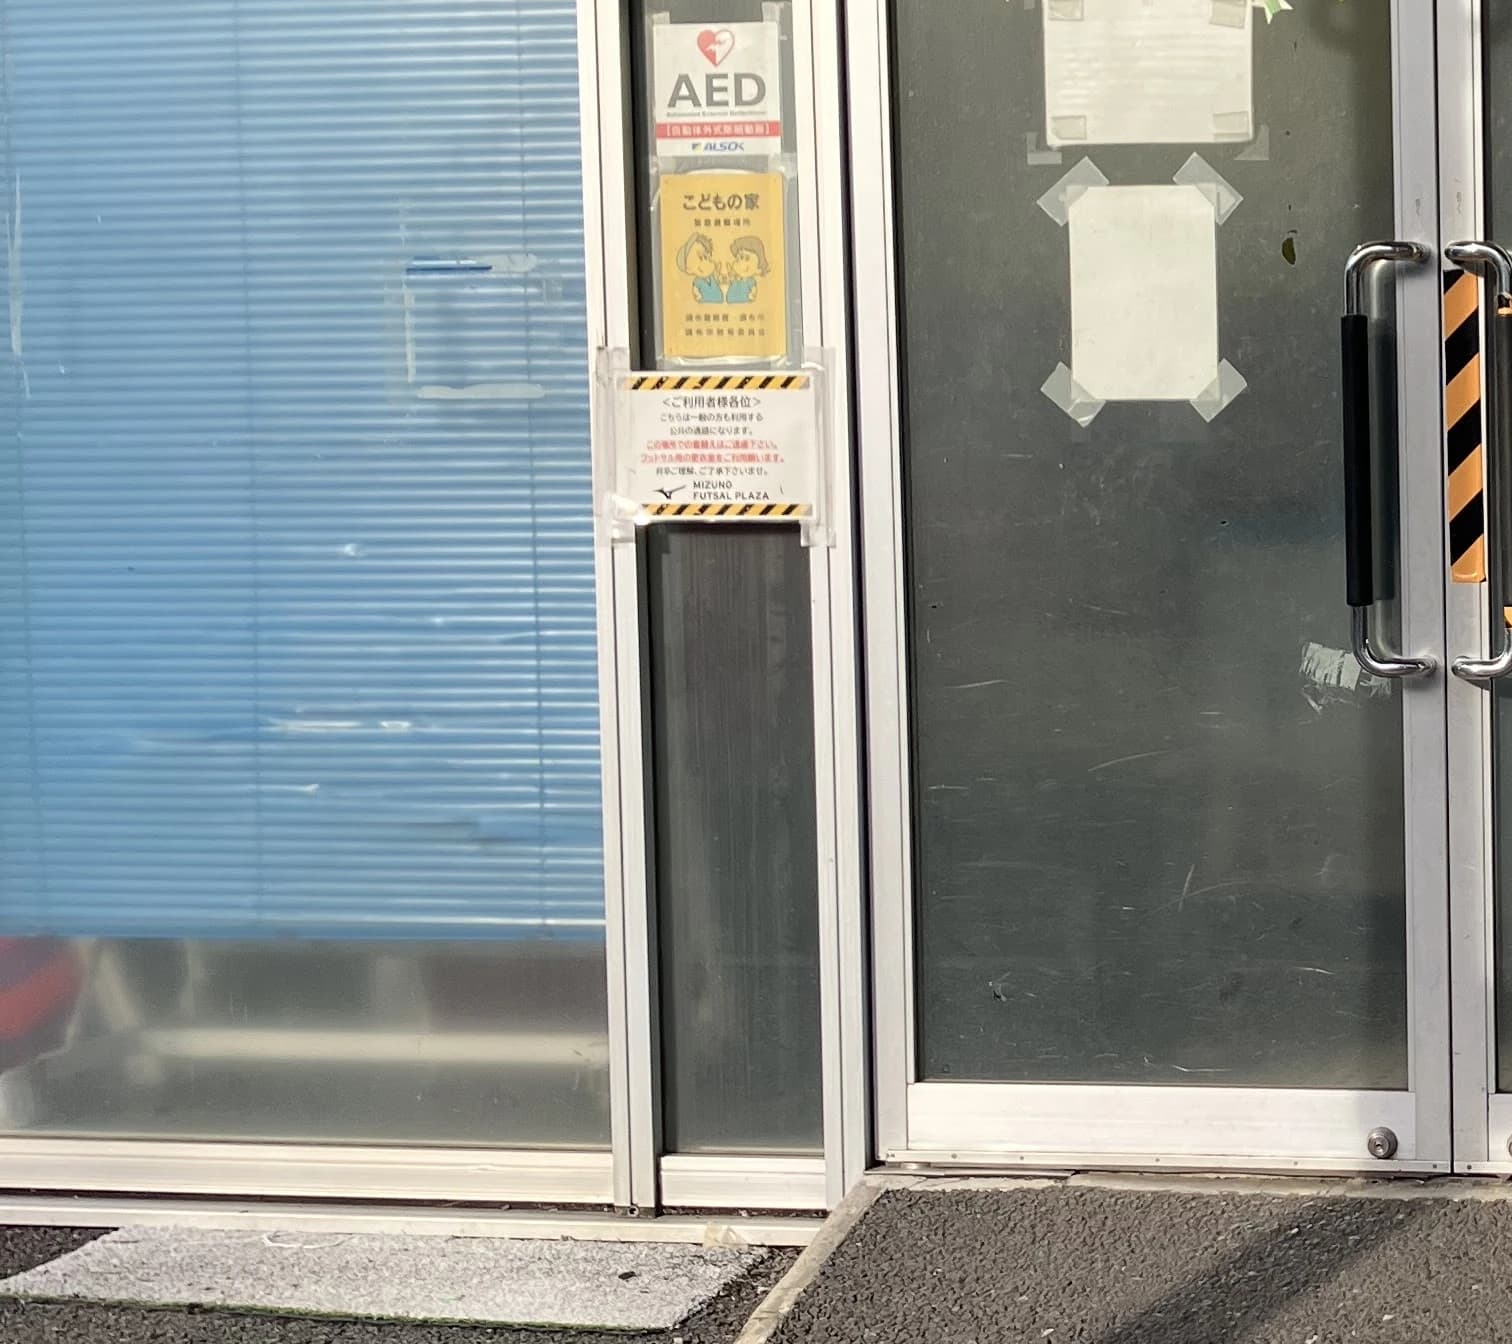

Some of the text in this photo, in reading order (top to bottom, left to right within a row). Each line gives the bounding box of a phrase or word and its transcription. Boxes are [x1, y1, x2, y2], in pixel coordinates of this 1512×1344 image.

[667, 72, 767, 108] AED
[703, 141, 745, 152] ALSOK
[682, 192, 760, 211] こどもの家
[693, 480, 733, 490] MIZUNO
[693, 490, 770, 500] FUTSAL PLAZA
